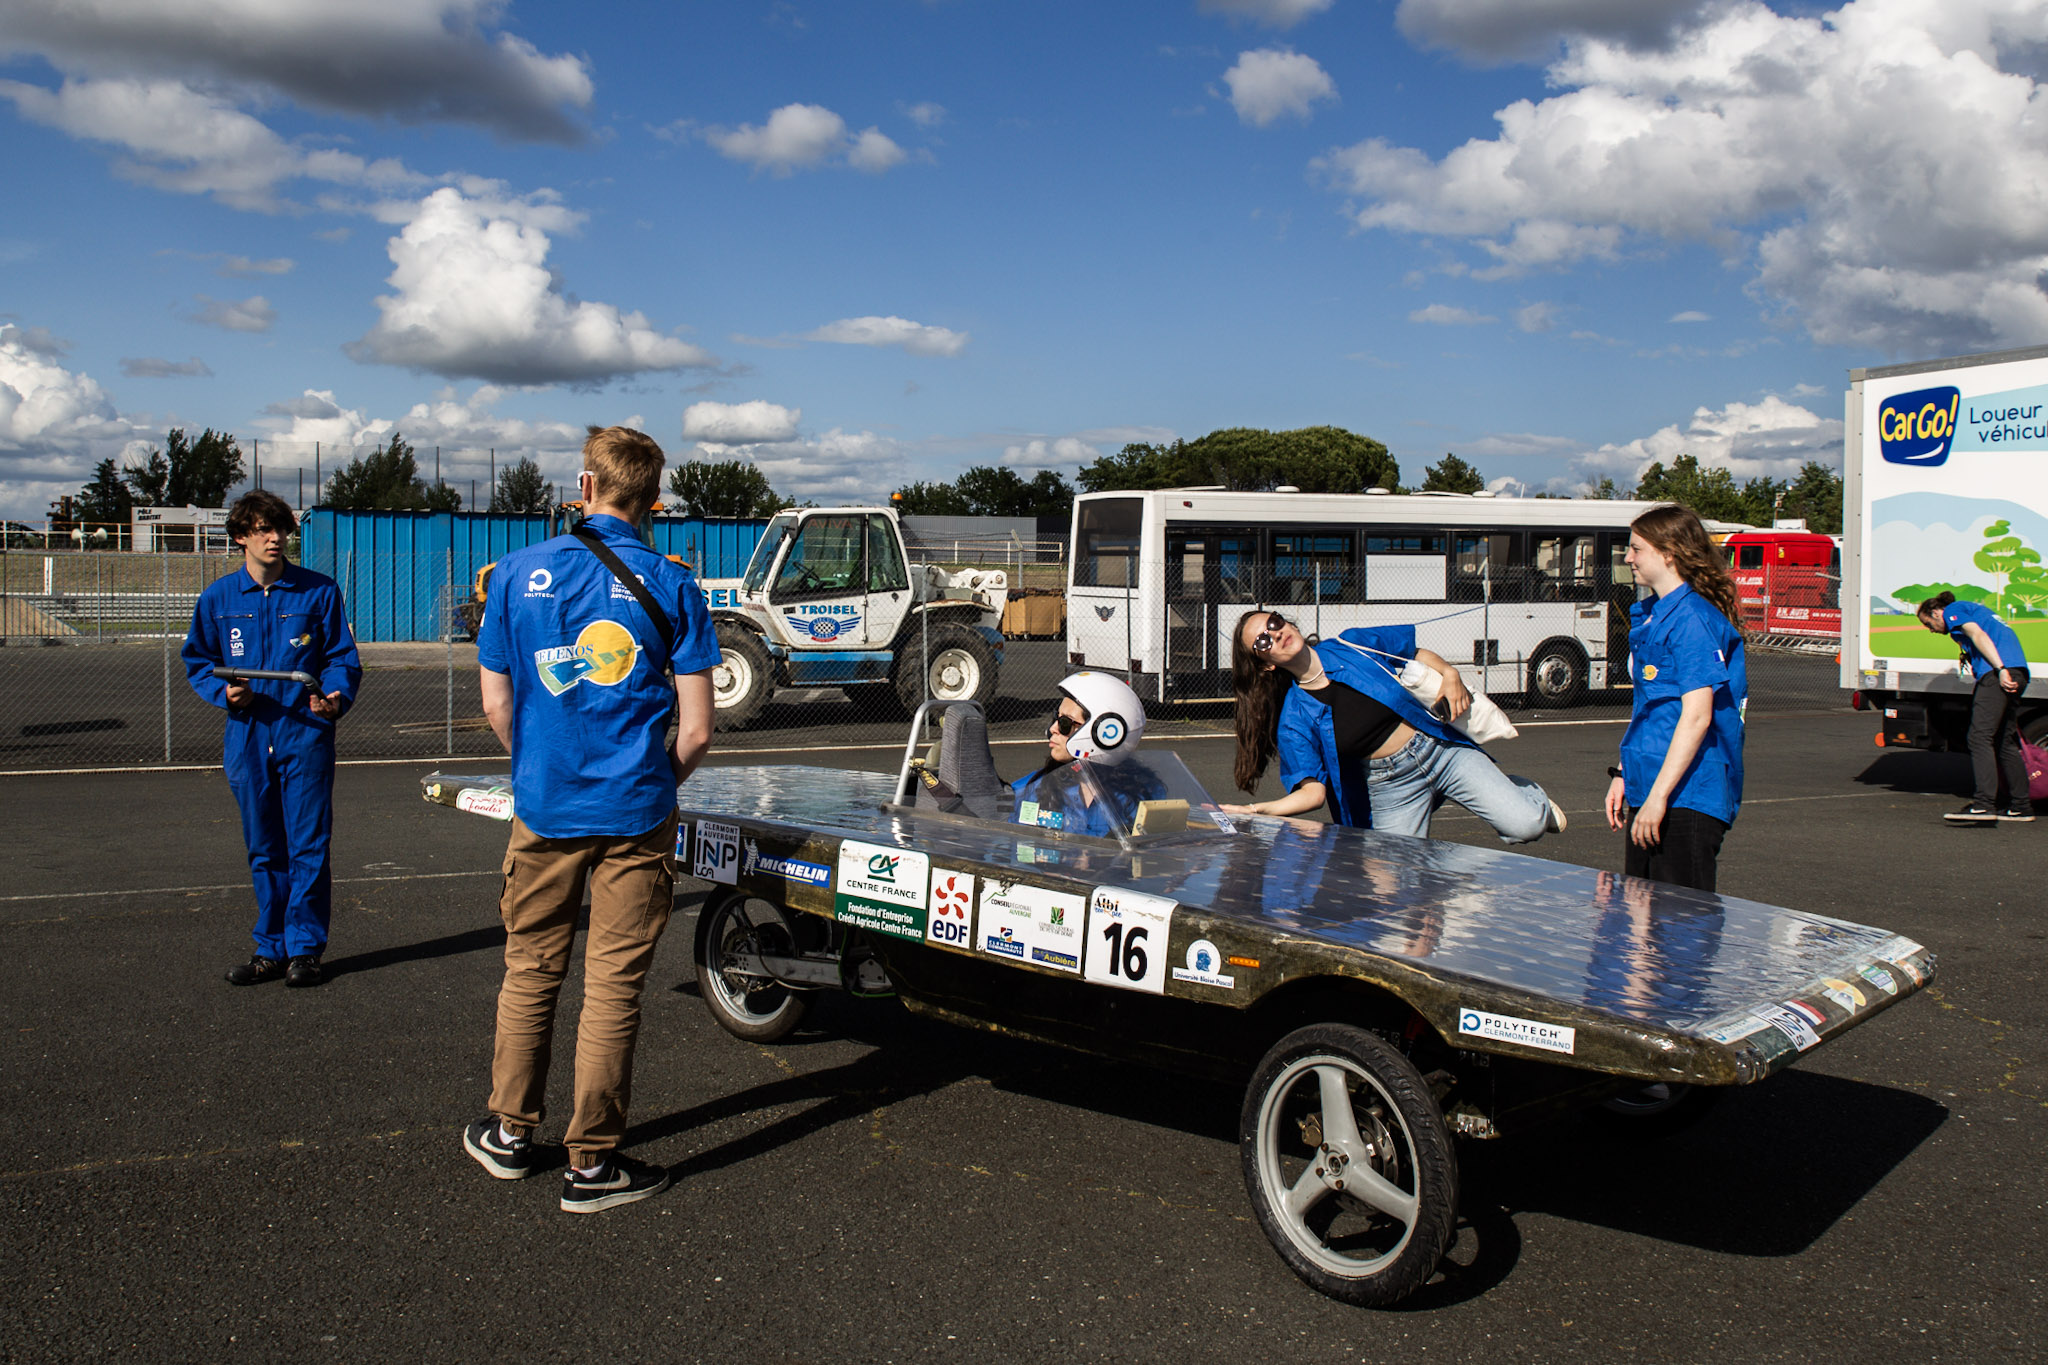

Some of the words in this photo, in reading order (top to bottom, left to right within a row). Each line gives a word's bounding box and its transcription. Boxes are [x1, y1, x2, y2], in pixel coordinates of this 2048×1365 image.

[1970, 405, 2043, 424] Loueur
[808, 518, 853, 529] AVIVA
[800, 605, 858, 615] TROISEL
[535, 644, 595, 665] BELENOS
[703, 829, 738, 842] AUVERGNE
[704, 822, 739, 835] CLERMONT
[759, 857, 829, 882] MICHELIN
[846, 879, 879, 893] CENTRE
[881, 886, 917, 900] FRANCE
[847, 901, 876, 917] Fondation
[876, 907, 914, 925] d'Entreprise
[837, 911, 856, 924] Crédit
[855, 915, 881, 929] Agricole
[880, 920, 902, 934] Centre
[901, 925, 923, 939] France
[988, 939, 1023, 951] CLERMONT
[1103, 921, 1149, 981] 16
[1043, 953, 1076, 967] Aubière
[1174, 971, 1199, 981] Université
[1215, 978, 1233, 987] Pascal
[1484, 1027, 1571, 1050] CLERMONT-FERRAND
[1485, 1018, 1558, 1039] POLYTECH
